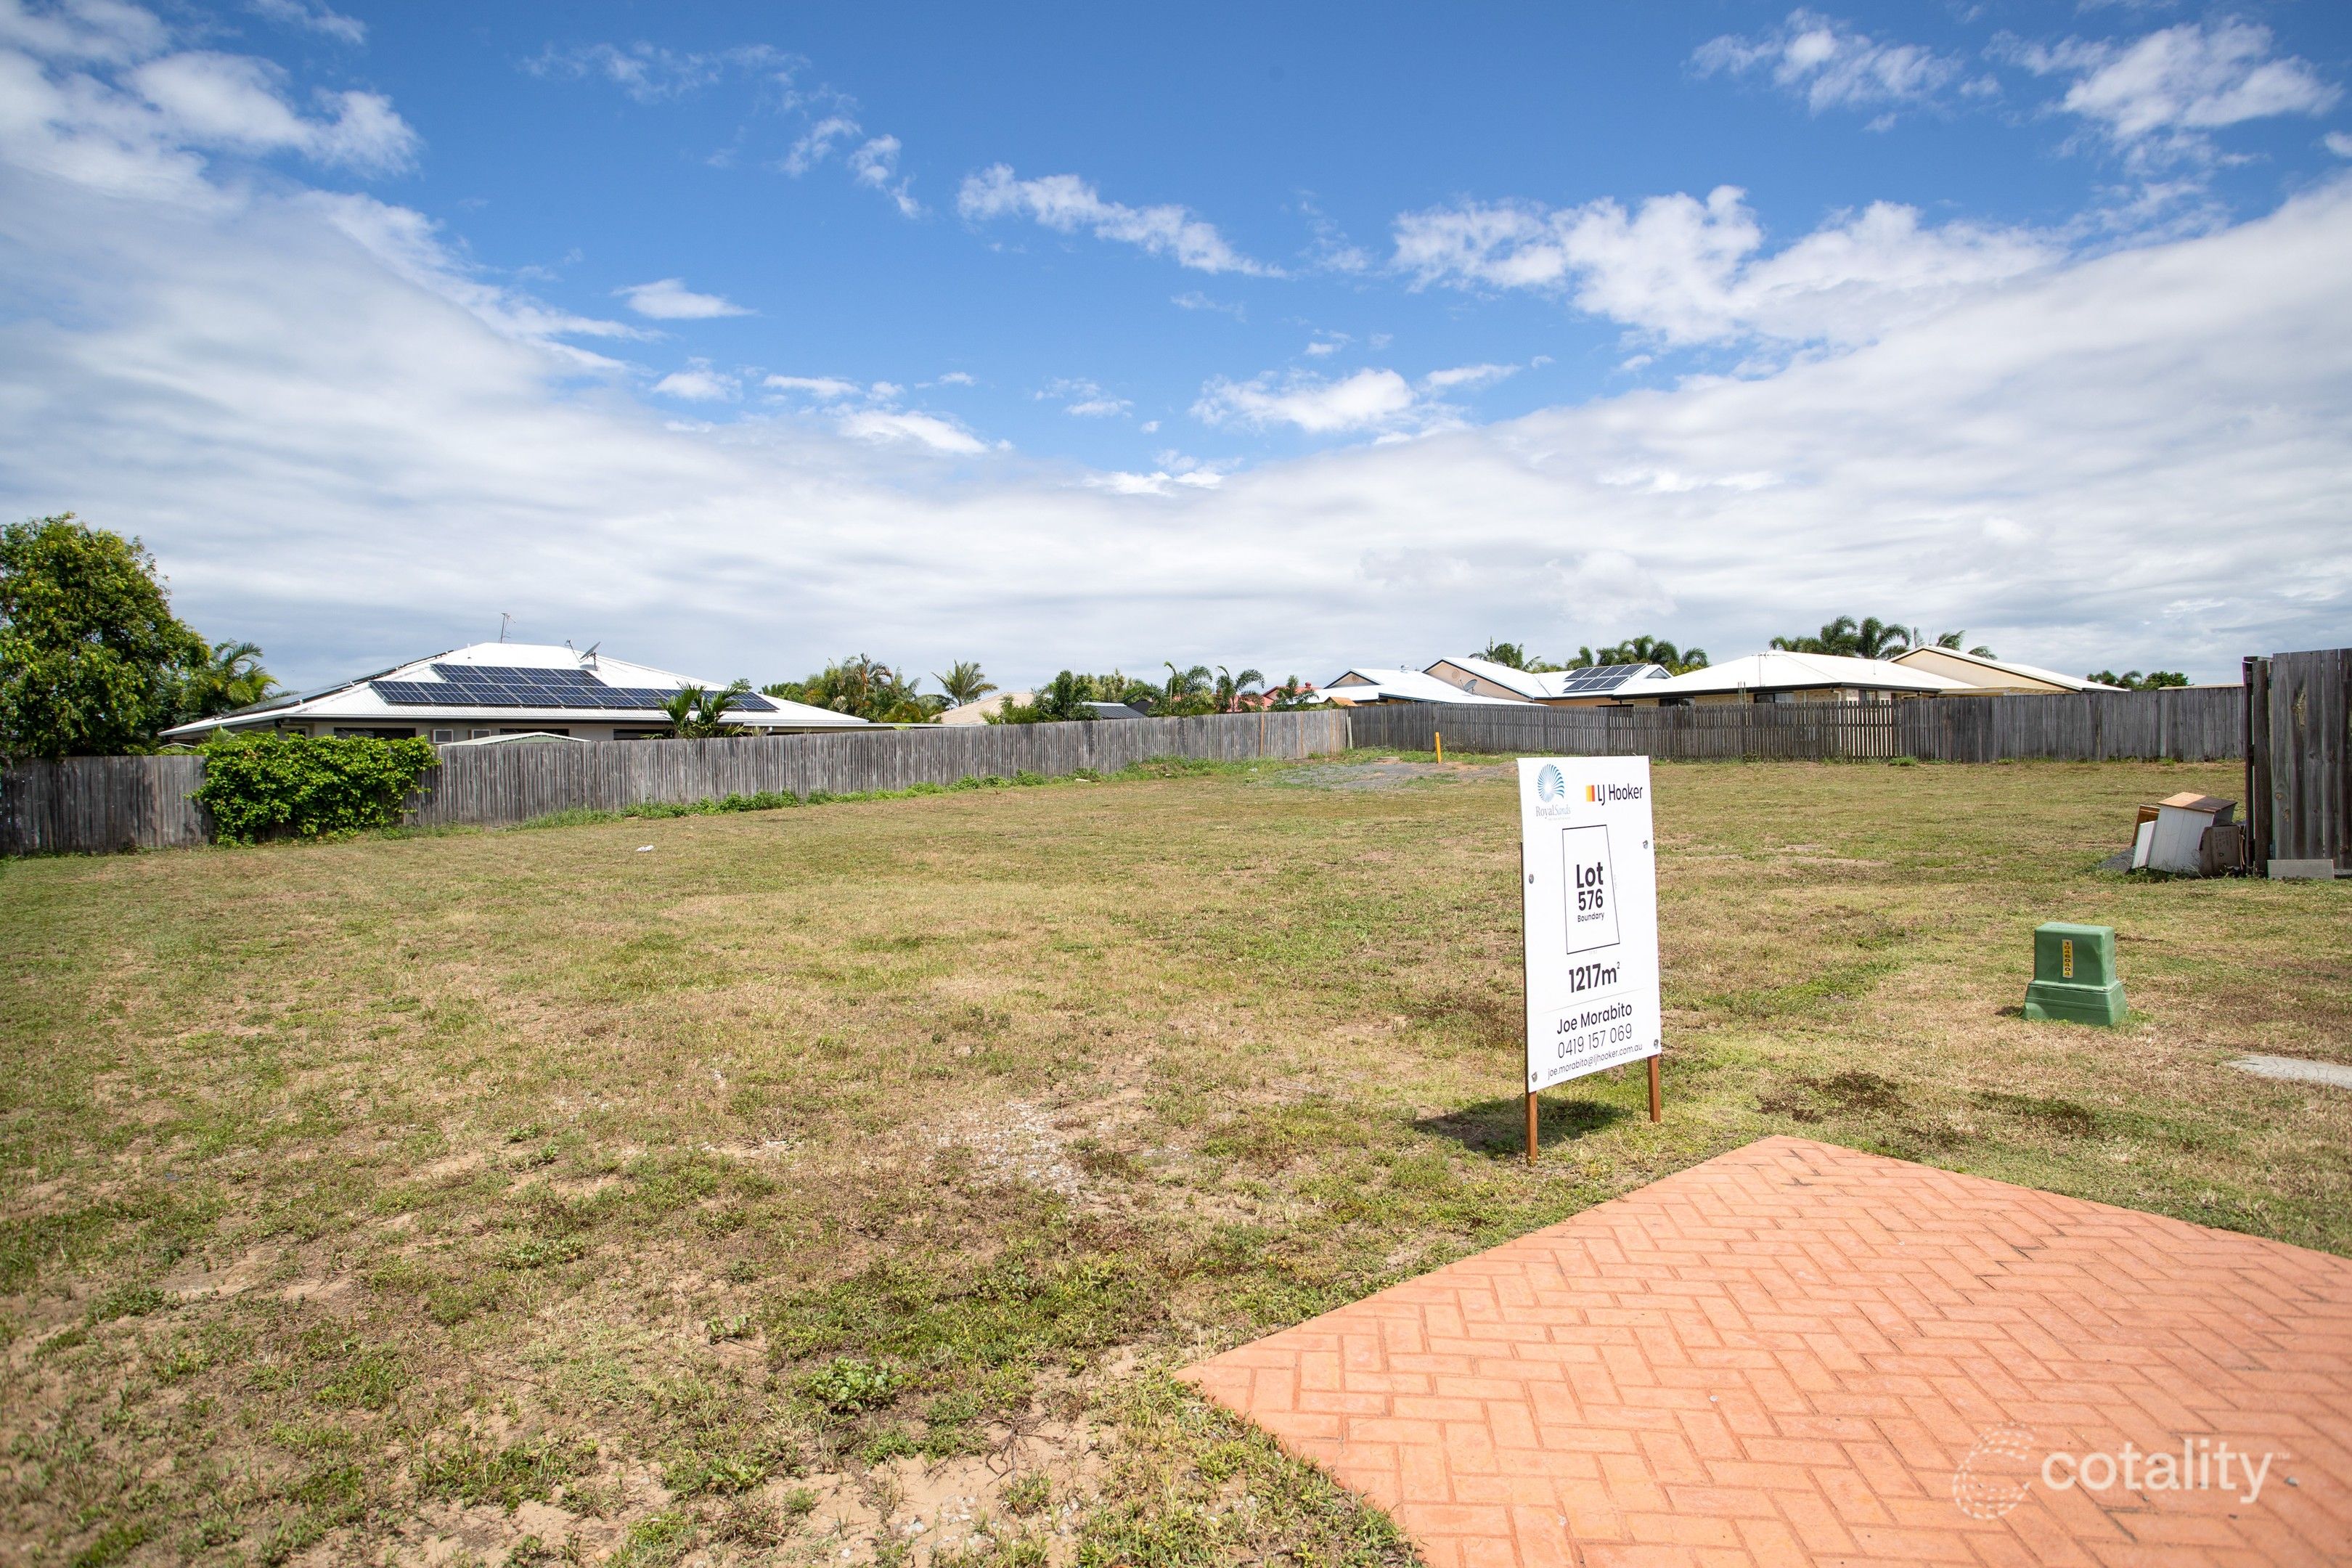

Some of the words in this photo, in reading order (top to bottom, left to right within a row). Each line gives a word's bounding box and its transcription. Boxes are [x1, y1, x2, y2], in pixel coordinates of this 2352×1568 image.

[1597, 784, 1606, 806] LJ
[1609, 783, 1643, 801] Hooker
[1576, 862, 1604, 889] Lot
[1578, 889, 1604, 911] 576
[1577, 912, 1605, 923] Boundary
[1556, 1018, 1577, 1034] Joe
[1580, 1003, 1633, 1029] Morabito
[1558, 1036, 1584, 1058] 0419
[1588, 1030, 1606, 1050] 157
[1610, 1023, 1632, 1043] 069
[1548, 1043, 1643, 1081] joe.morabito@ljhooker.com.au
